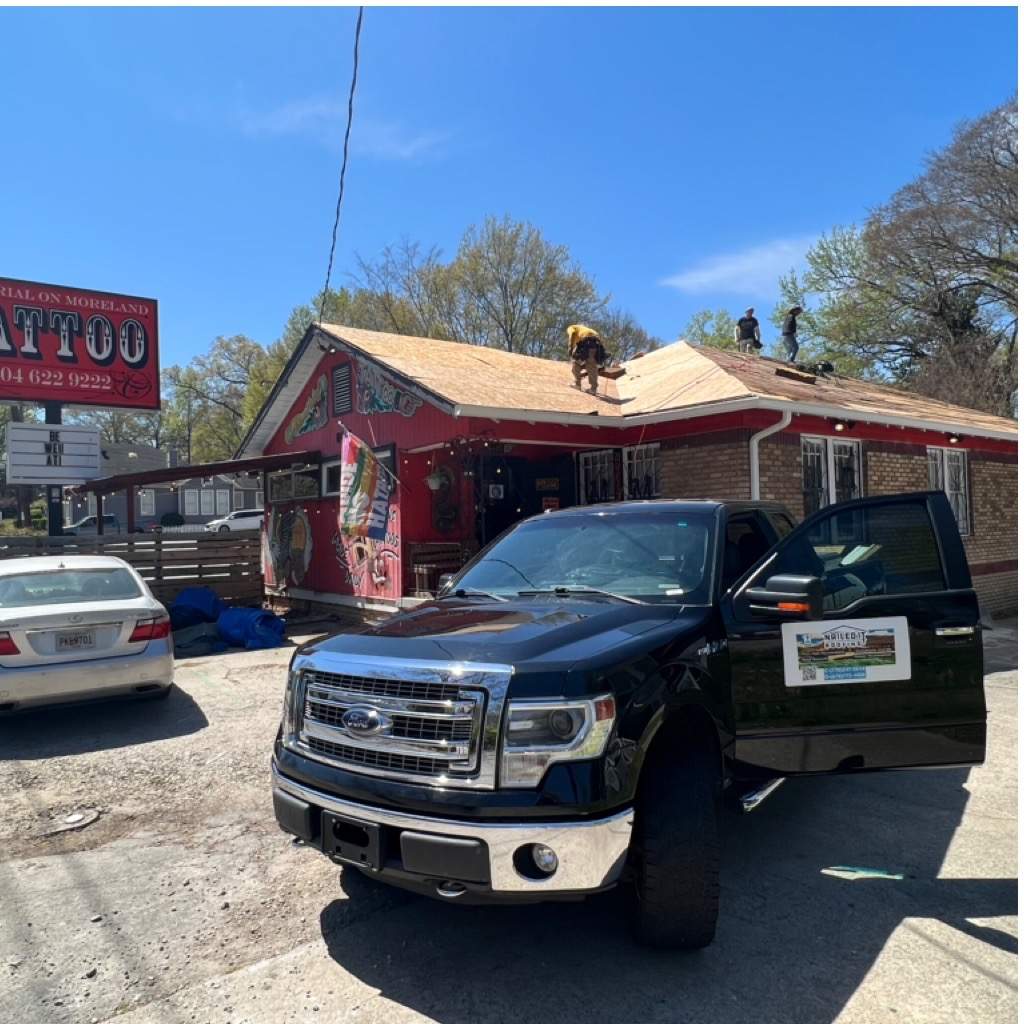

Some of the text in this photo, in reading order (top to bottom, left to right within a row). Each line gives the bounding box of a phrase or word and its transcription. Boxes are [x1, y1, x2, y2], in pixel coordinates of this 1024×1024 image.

[38, 291, 62, 304] ON
[66, 295, 150, 316] MORELAND
[29, 369, 65, 387] 622
[68, 372, 113, 390] 9222
